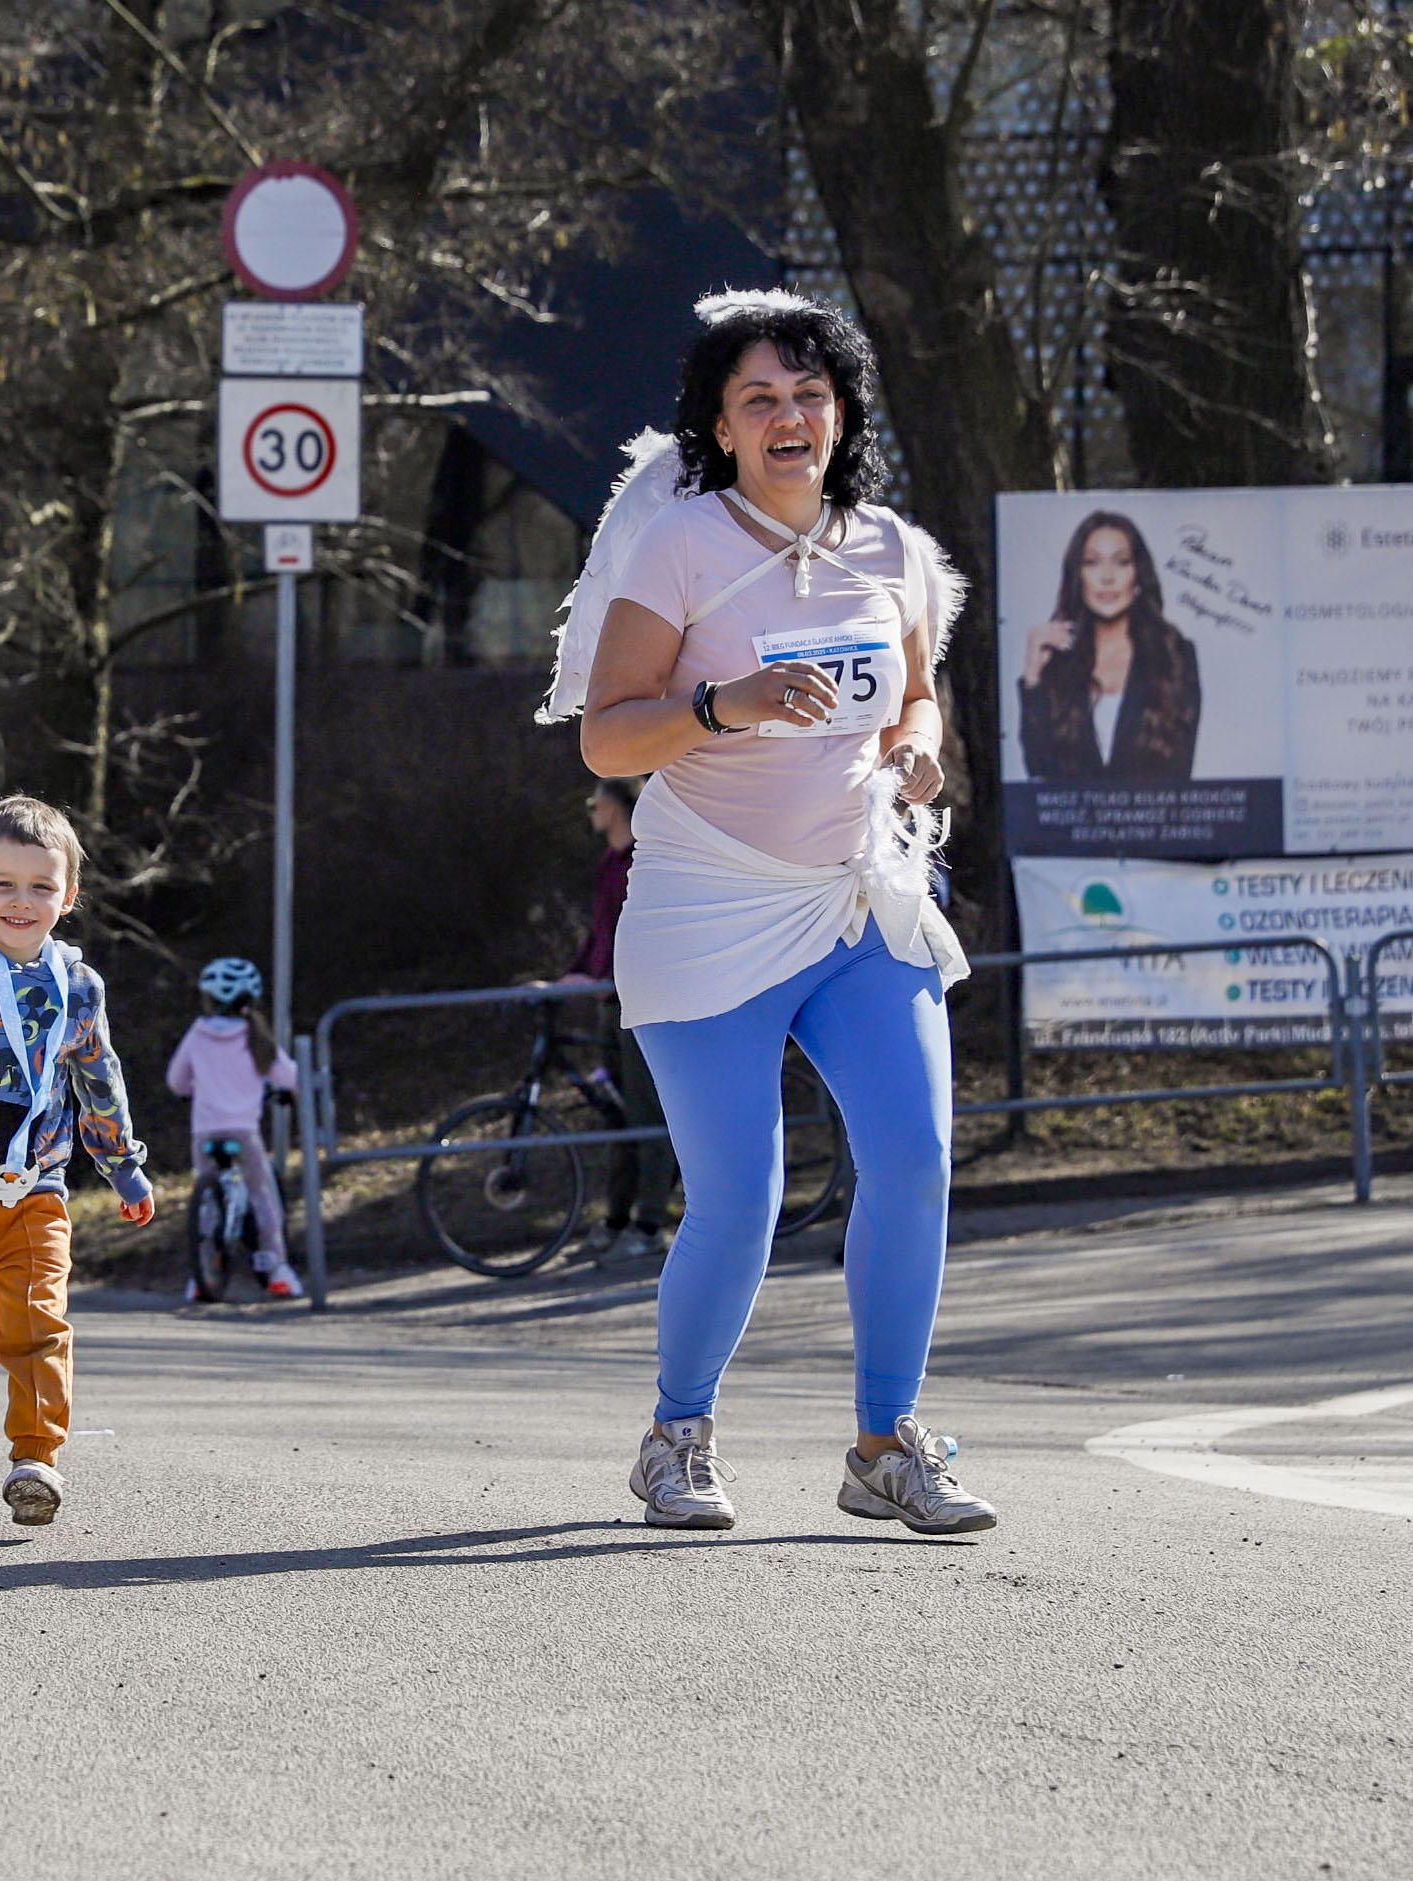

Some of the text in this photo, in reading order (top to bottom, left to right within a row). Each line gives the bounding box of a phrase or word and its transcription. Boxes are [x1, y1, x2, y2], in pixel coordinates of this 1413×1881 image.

[259, 429, 323, 471] 30
[1236, 873, 1304, 897] TESTY
[1310, 873, 1317, 894] I
[1240, 906, 1413, 932] OZONOTERAPIA
[1247, 978, 1316, 1000] TESTY
